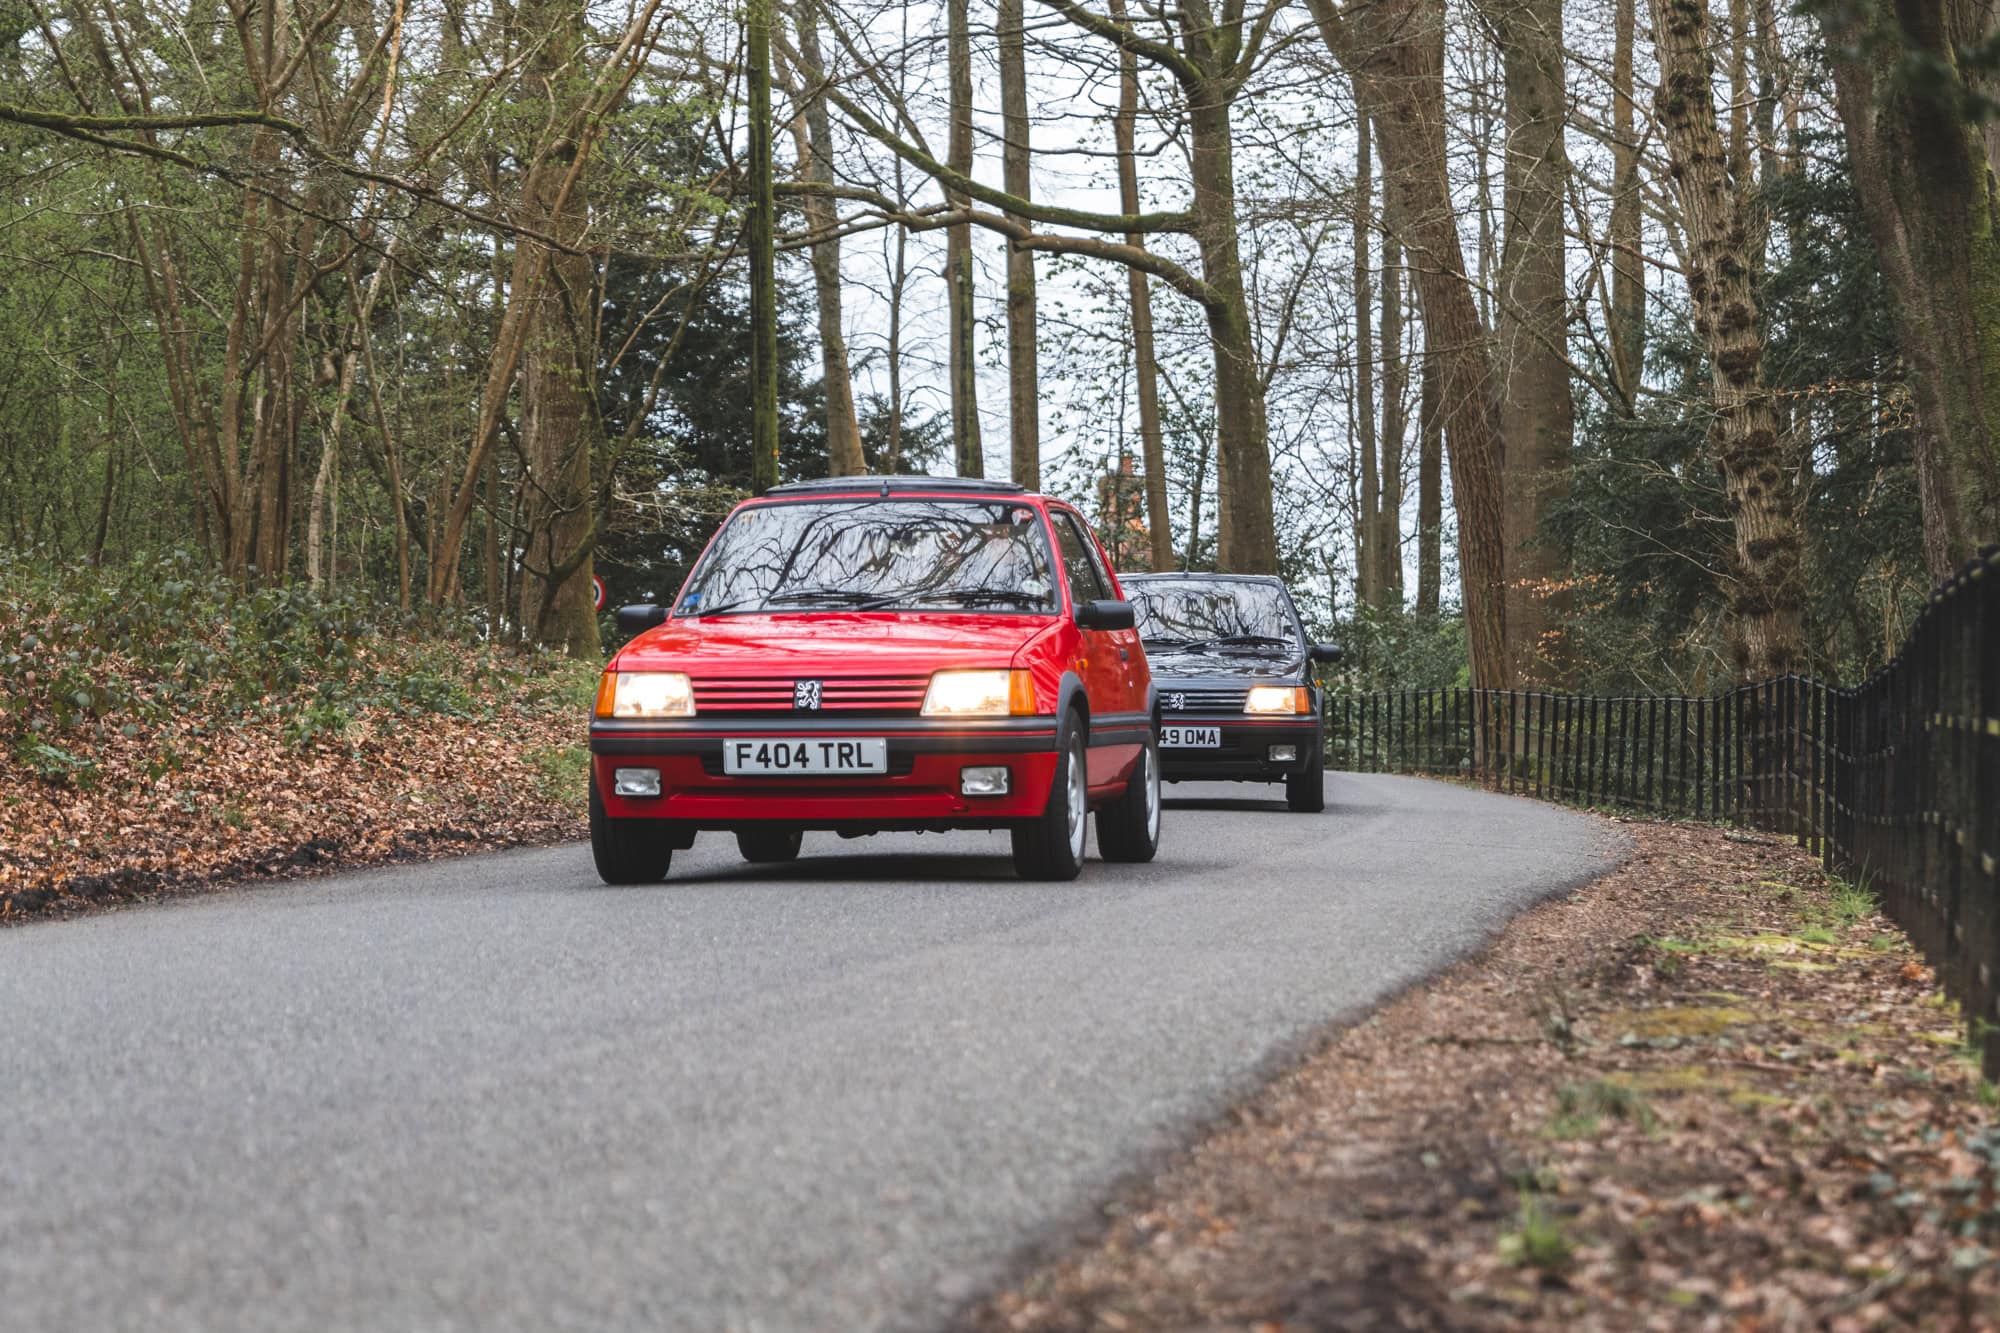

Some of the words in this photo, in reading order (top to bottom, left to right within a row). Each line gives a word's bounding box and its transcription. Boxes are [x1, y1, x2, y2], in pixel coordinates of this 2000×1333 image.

[1185, 729, 1217, 745] OMA
[736, 743, 809, 769] F404
[818, 742, 873, 768] TRL
